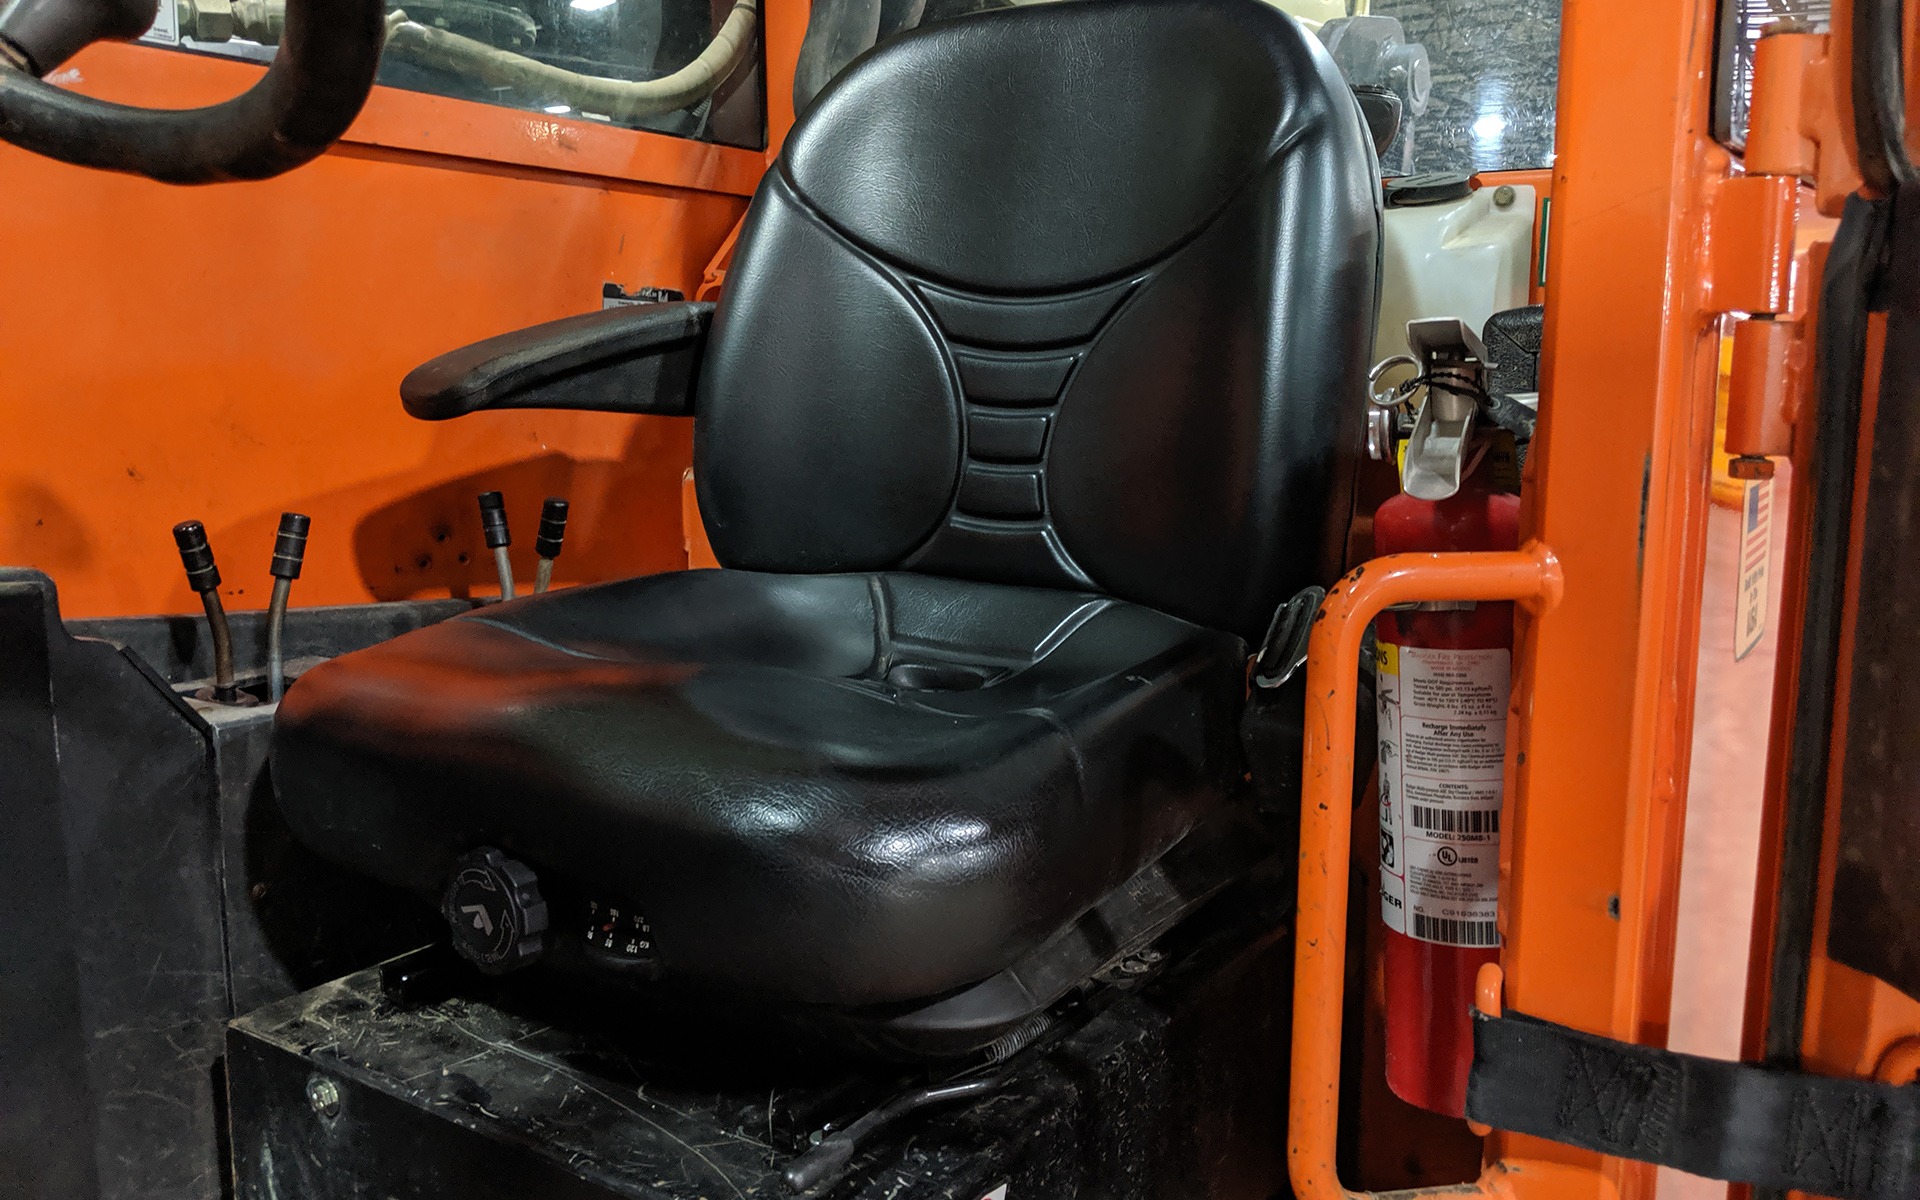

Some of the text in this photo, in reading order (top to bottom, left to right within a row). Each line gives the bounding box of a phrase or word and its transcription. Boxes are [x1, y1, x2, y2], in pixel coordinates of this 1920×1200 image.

[1422, 722, 1487, 732] Recharge Immediately
[1426, 831, 1455, 841] MODEL:
[1442, 850, 1453, 862] UL
